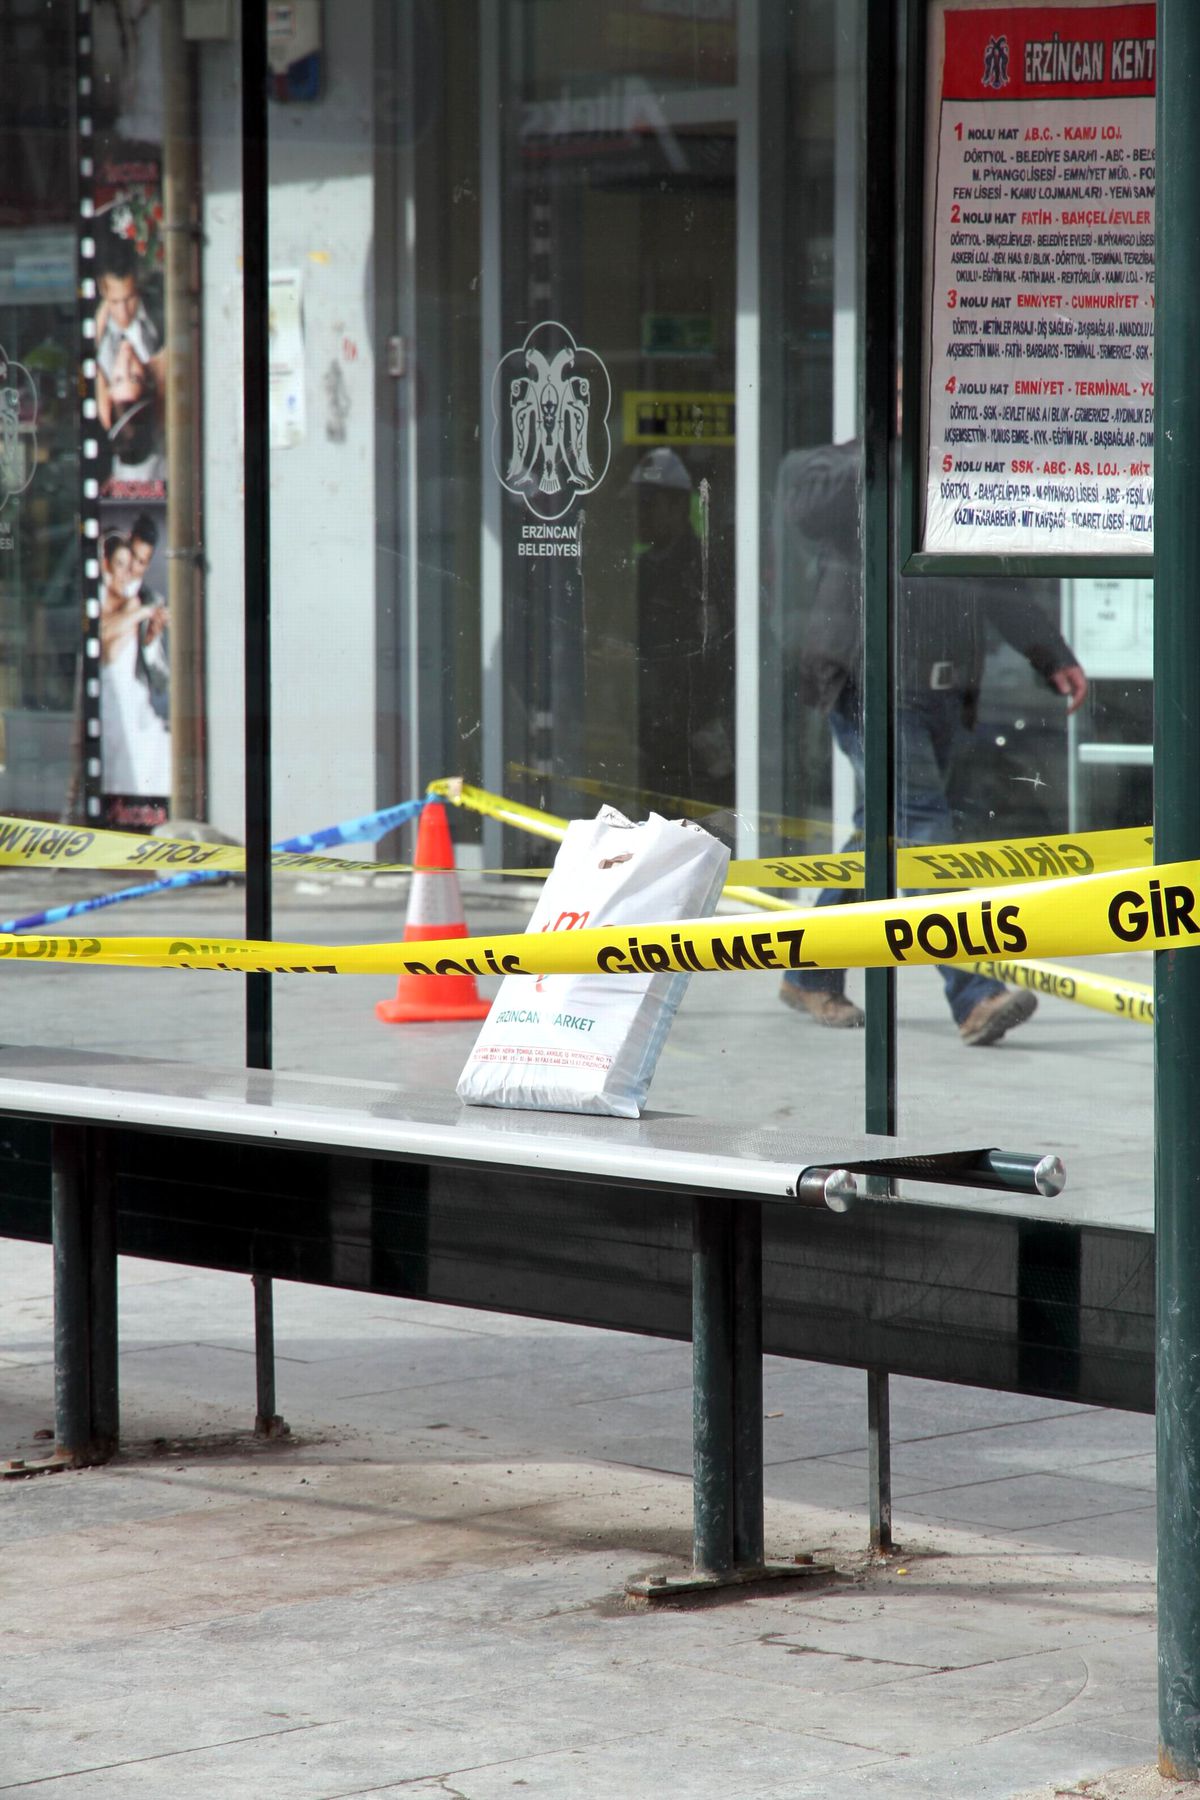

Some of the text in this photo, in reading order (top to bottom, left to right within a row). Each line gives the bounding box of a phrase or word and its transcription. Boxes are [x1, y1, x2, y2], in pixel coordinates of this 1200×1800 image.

[1025, 32, 1155, 81] ERZİNCAN KENT
[954, 122, 963, 141] 1
[968, 129, 995, 140] NOLU
[999, 129, 1019, 140] HAT
[964, 148, 1006, 162] DÖRTYOL
[1016, 148, 1060, 163] BELEDİYE
[1105, 149, 1124, 162] ABC
[1064, 166, 1106, 180] EMNİYET
[953, 187, 972, 199] FEN
[974, 185, 1001, 199] LİSESİ
[951, 205, 1150, 227] 2 NOLU HAT FATİH BAHÇELİEVLER
[951, 232, 981, 246] DÖRTYOL
[1038, 232, 1068, 246] BELEDİYE
[1070, 232, 1092, 246] EVLERİ
[951, 250, 974, 264] ASKERİ
[1056, 250, 1086, 265] DÖRTYOL
[947, 289, 957, 309] 3
[960, 297, 988, 307] NOLU
[992, 297, 1012, 307] HAT
[1017, 292, 1062, 308] EMNİYET
[1072, 292, 1139, 308] CUMHURİYET
[953, 317, 978, 335] DÖRTYOL
[1064, 340, 1095, 358] TERMİNAL
[945, 376, 956, 394] 4
[958, 383, 986, 395] NOLU
[990, 384, 1009, 395] HAT
[1015, 378, 1064, 395] EMNİYET
[1075, 379, 1130, 396] TERMİNAL
[951, 402, 978, 420] DÖRTYOL
[983, 405, 997, 421] SGK
[1094, 427, 1135, 450] BAŞBAĞLAR
[943, 455, 1150, 476] 5 NOLU HAT SSK ABC AS. LOJ. MİT
[1106, 488, 1120, 503] ABC
[522, 523, 577, 539] ERZİNCAN
[597, 930, 818, 976] GİRİLMEZ
[885, 901, 1027, 961] POLİS
[555, 1013, 596, 1032] ARKET
